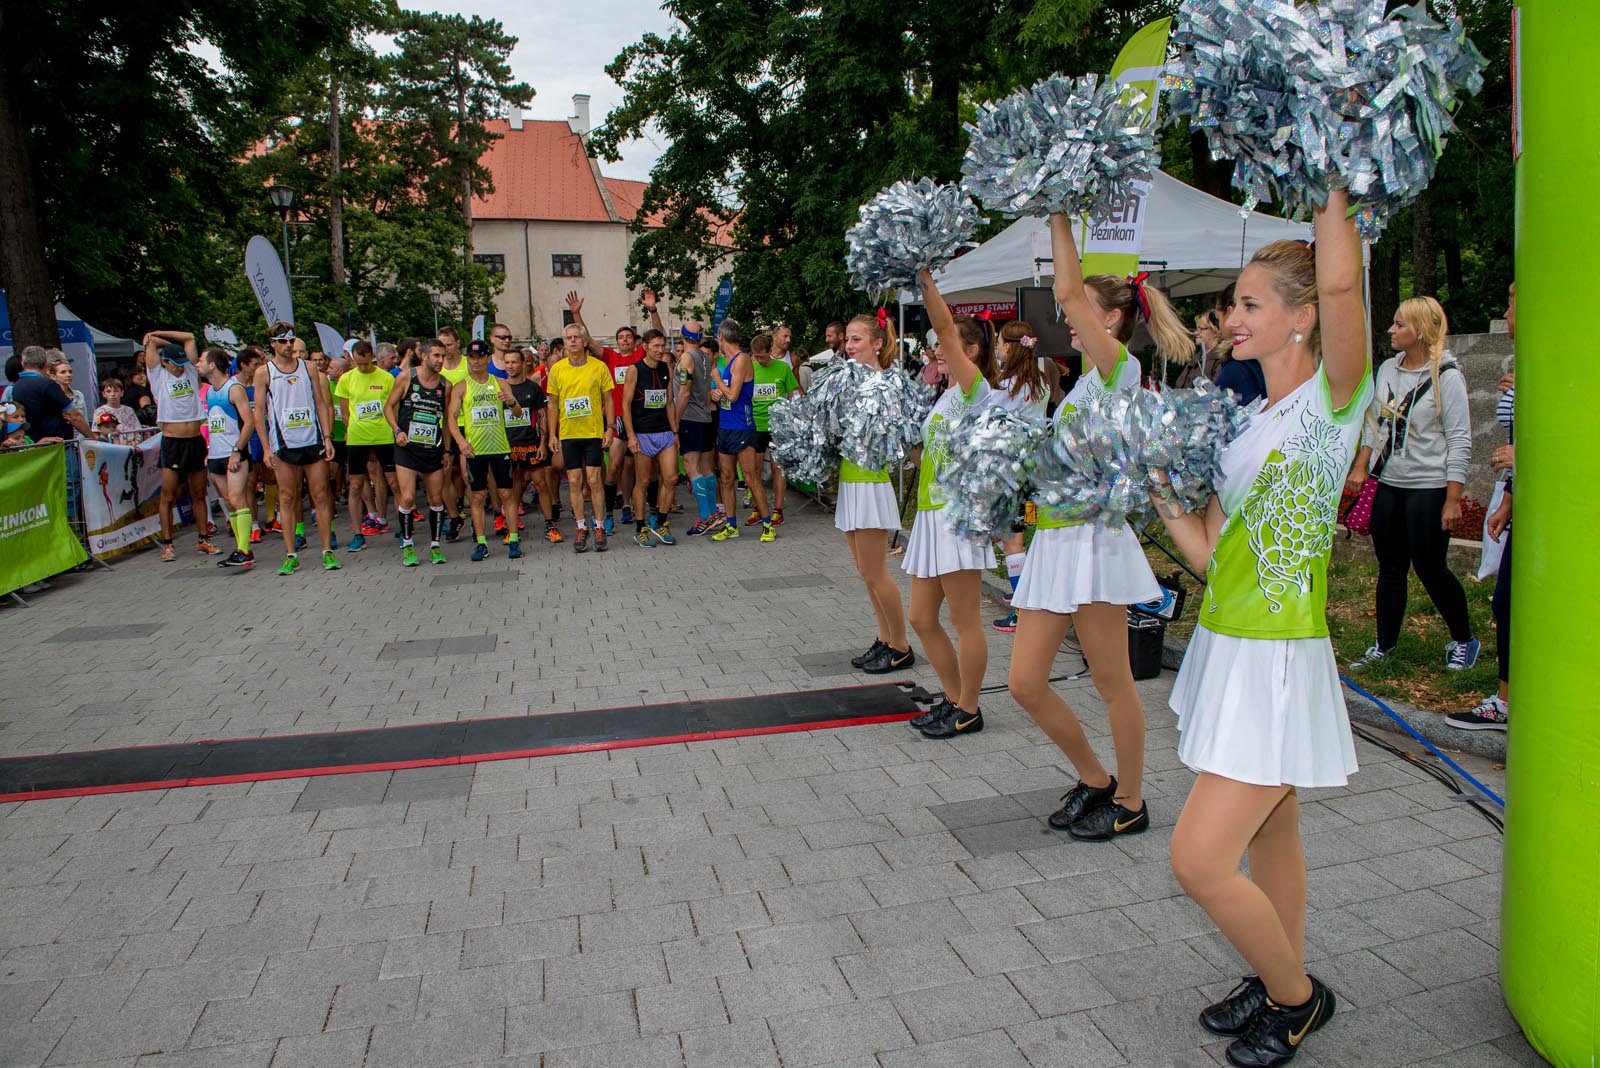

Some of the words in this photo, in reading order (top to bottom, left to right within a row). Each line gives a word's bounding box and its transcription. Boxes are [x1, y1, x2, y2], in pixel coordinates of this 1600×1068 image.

[1091, 225, 1135, 241] Pezinkom
[956, 304, 985, 314] SUPER
[172, 381, 189, 391] 593
[757, 387, 772, 395] 450
[649, 393, 663, 402] 408
[361, 405, 377, 414] 284
[569, 402, 585, 411] 565
[288, 412, 306, 421] 457
[477, 411, 494, 419] 104
[415, 428, 432, 437] 579
